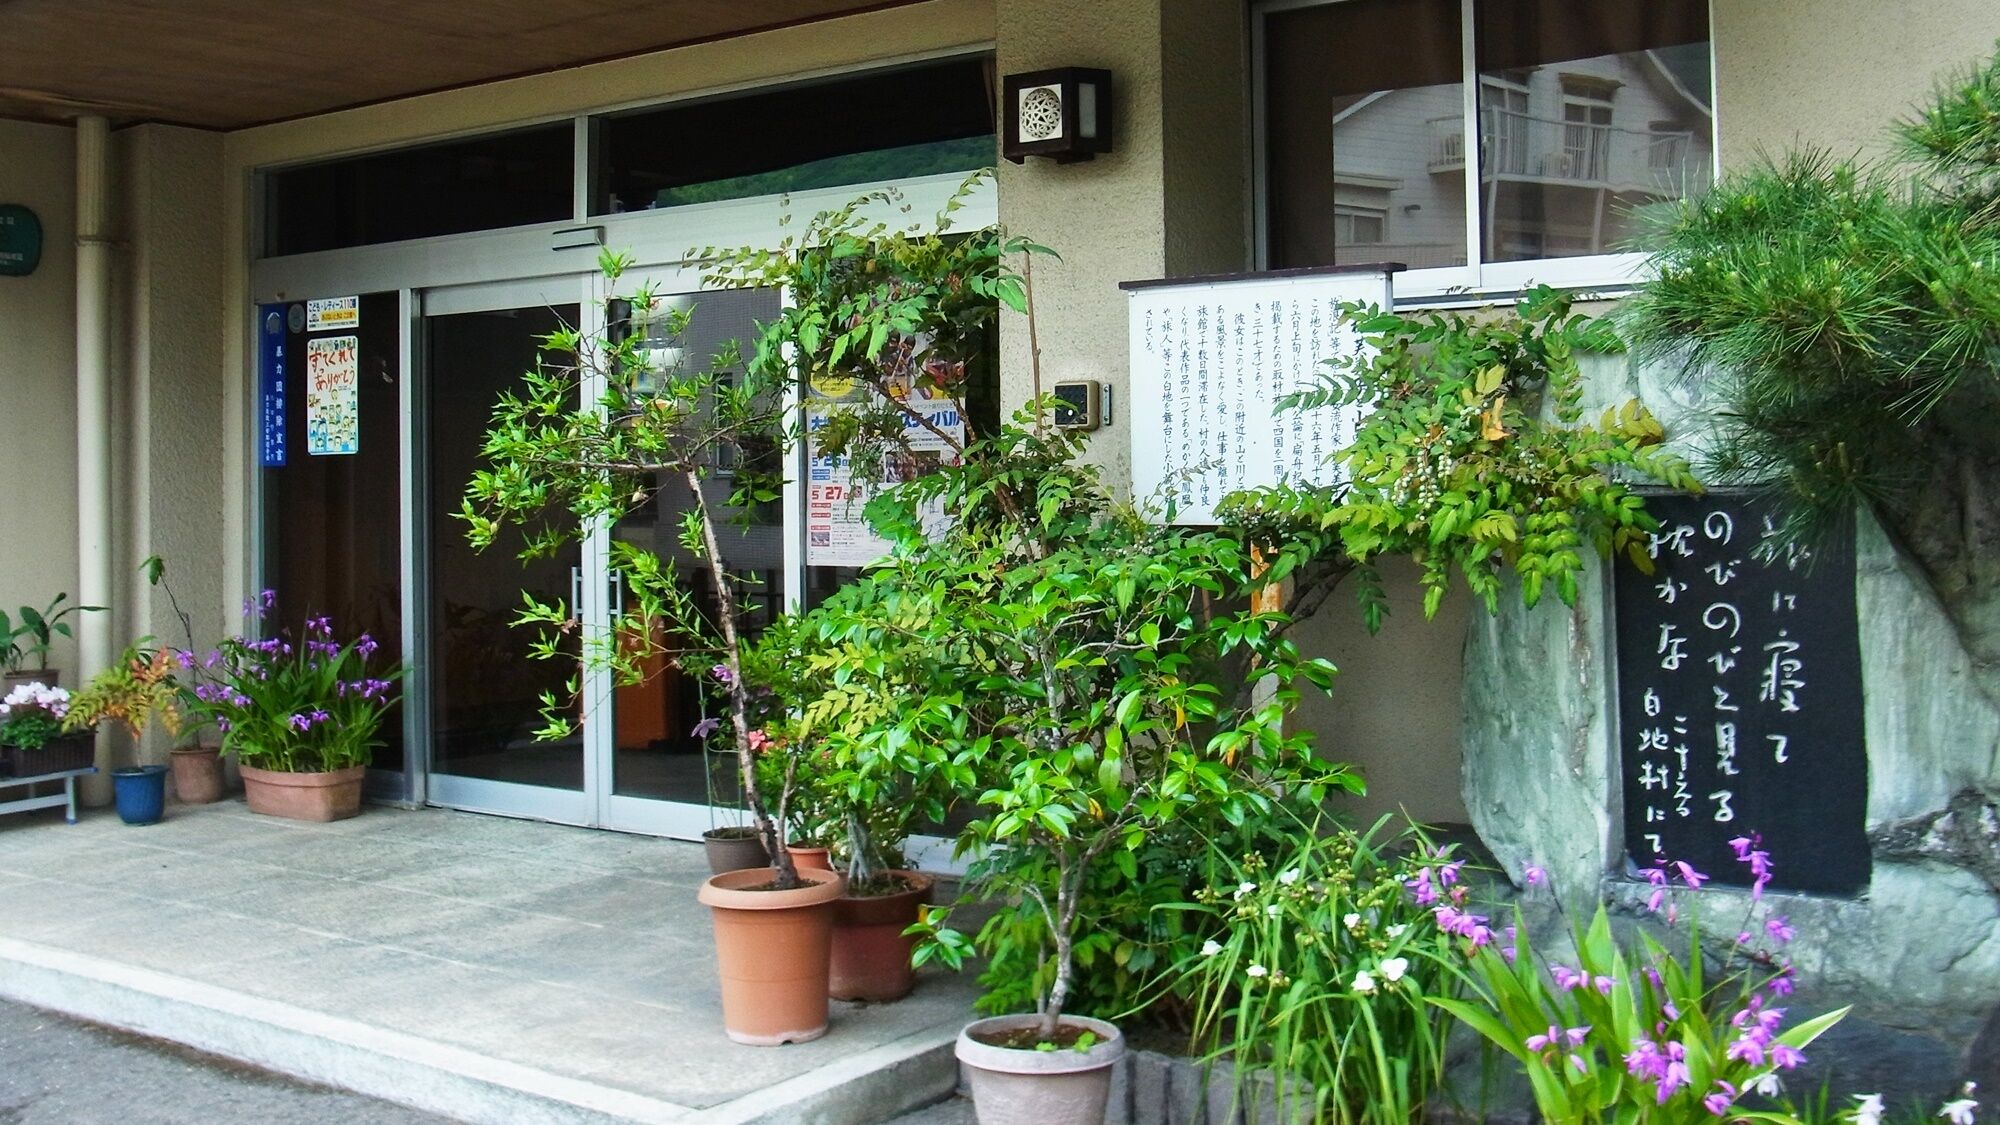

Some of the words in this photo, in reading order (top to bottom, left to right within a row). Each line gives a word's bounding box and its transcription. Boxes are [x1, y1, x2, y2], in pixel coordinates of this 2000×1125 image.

[314, 366, 355, 392] ありがとう
[811, 490, 819, 500] 5
[1703, 510, 1743, 822] のびのびと見る
[1637, 687, 1669, 853] 白地村にて
